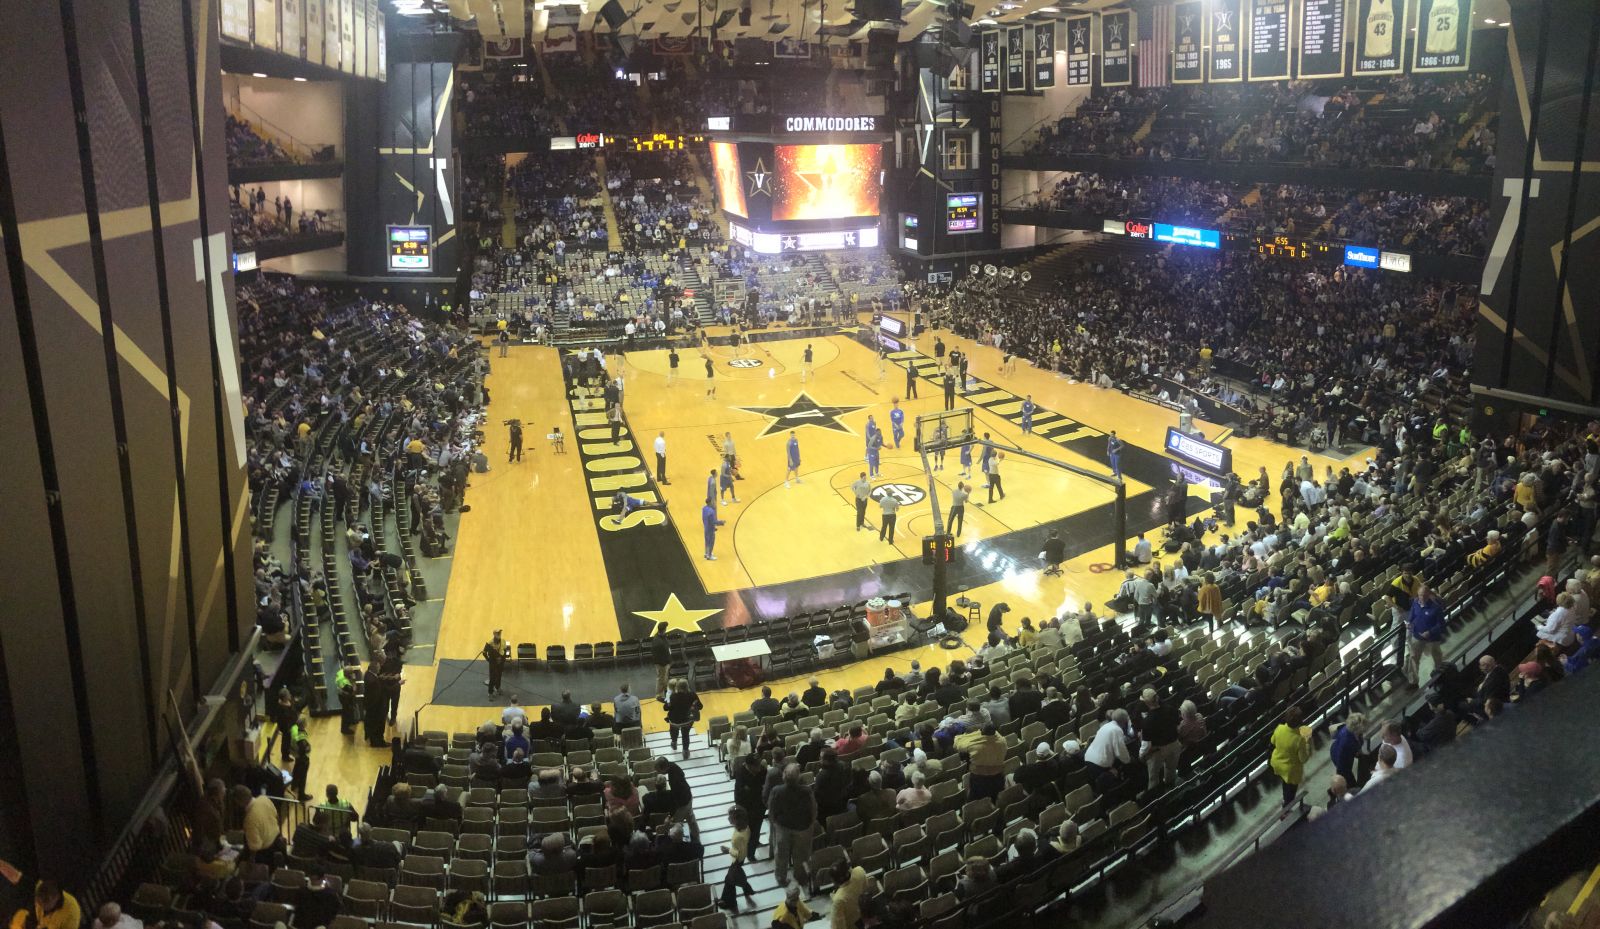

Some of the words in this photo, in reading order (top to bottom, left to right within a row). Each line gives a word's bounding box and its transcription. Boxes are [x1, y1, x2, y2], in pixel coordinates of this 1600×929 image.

[1373, 22, 1386, 36] 43
[1436, 17, 1450, 31] 25
[1215, 58, 1232, 70] 1965
[786, 116, 875, 132] COMMODORES
[577, 133, 599, 143] Coke
[1126, 221, 1148, 234] Coke
[730, 359, 761, 367] SEC
[570, 377, 665, 531] OMMODORES
[1180, 441, 1194, 452] CBS
[1194, 445, 1220, 461] SPORTS
[872, 484, 923, 505] SEC
